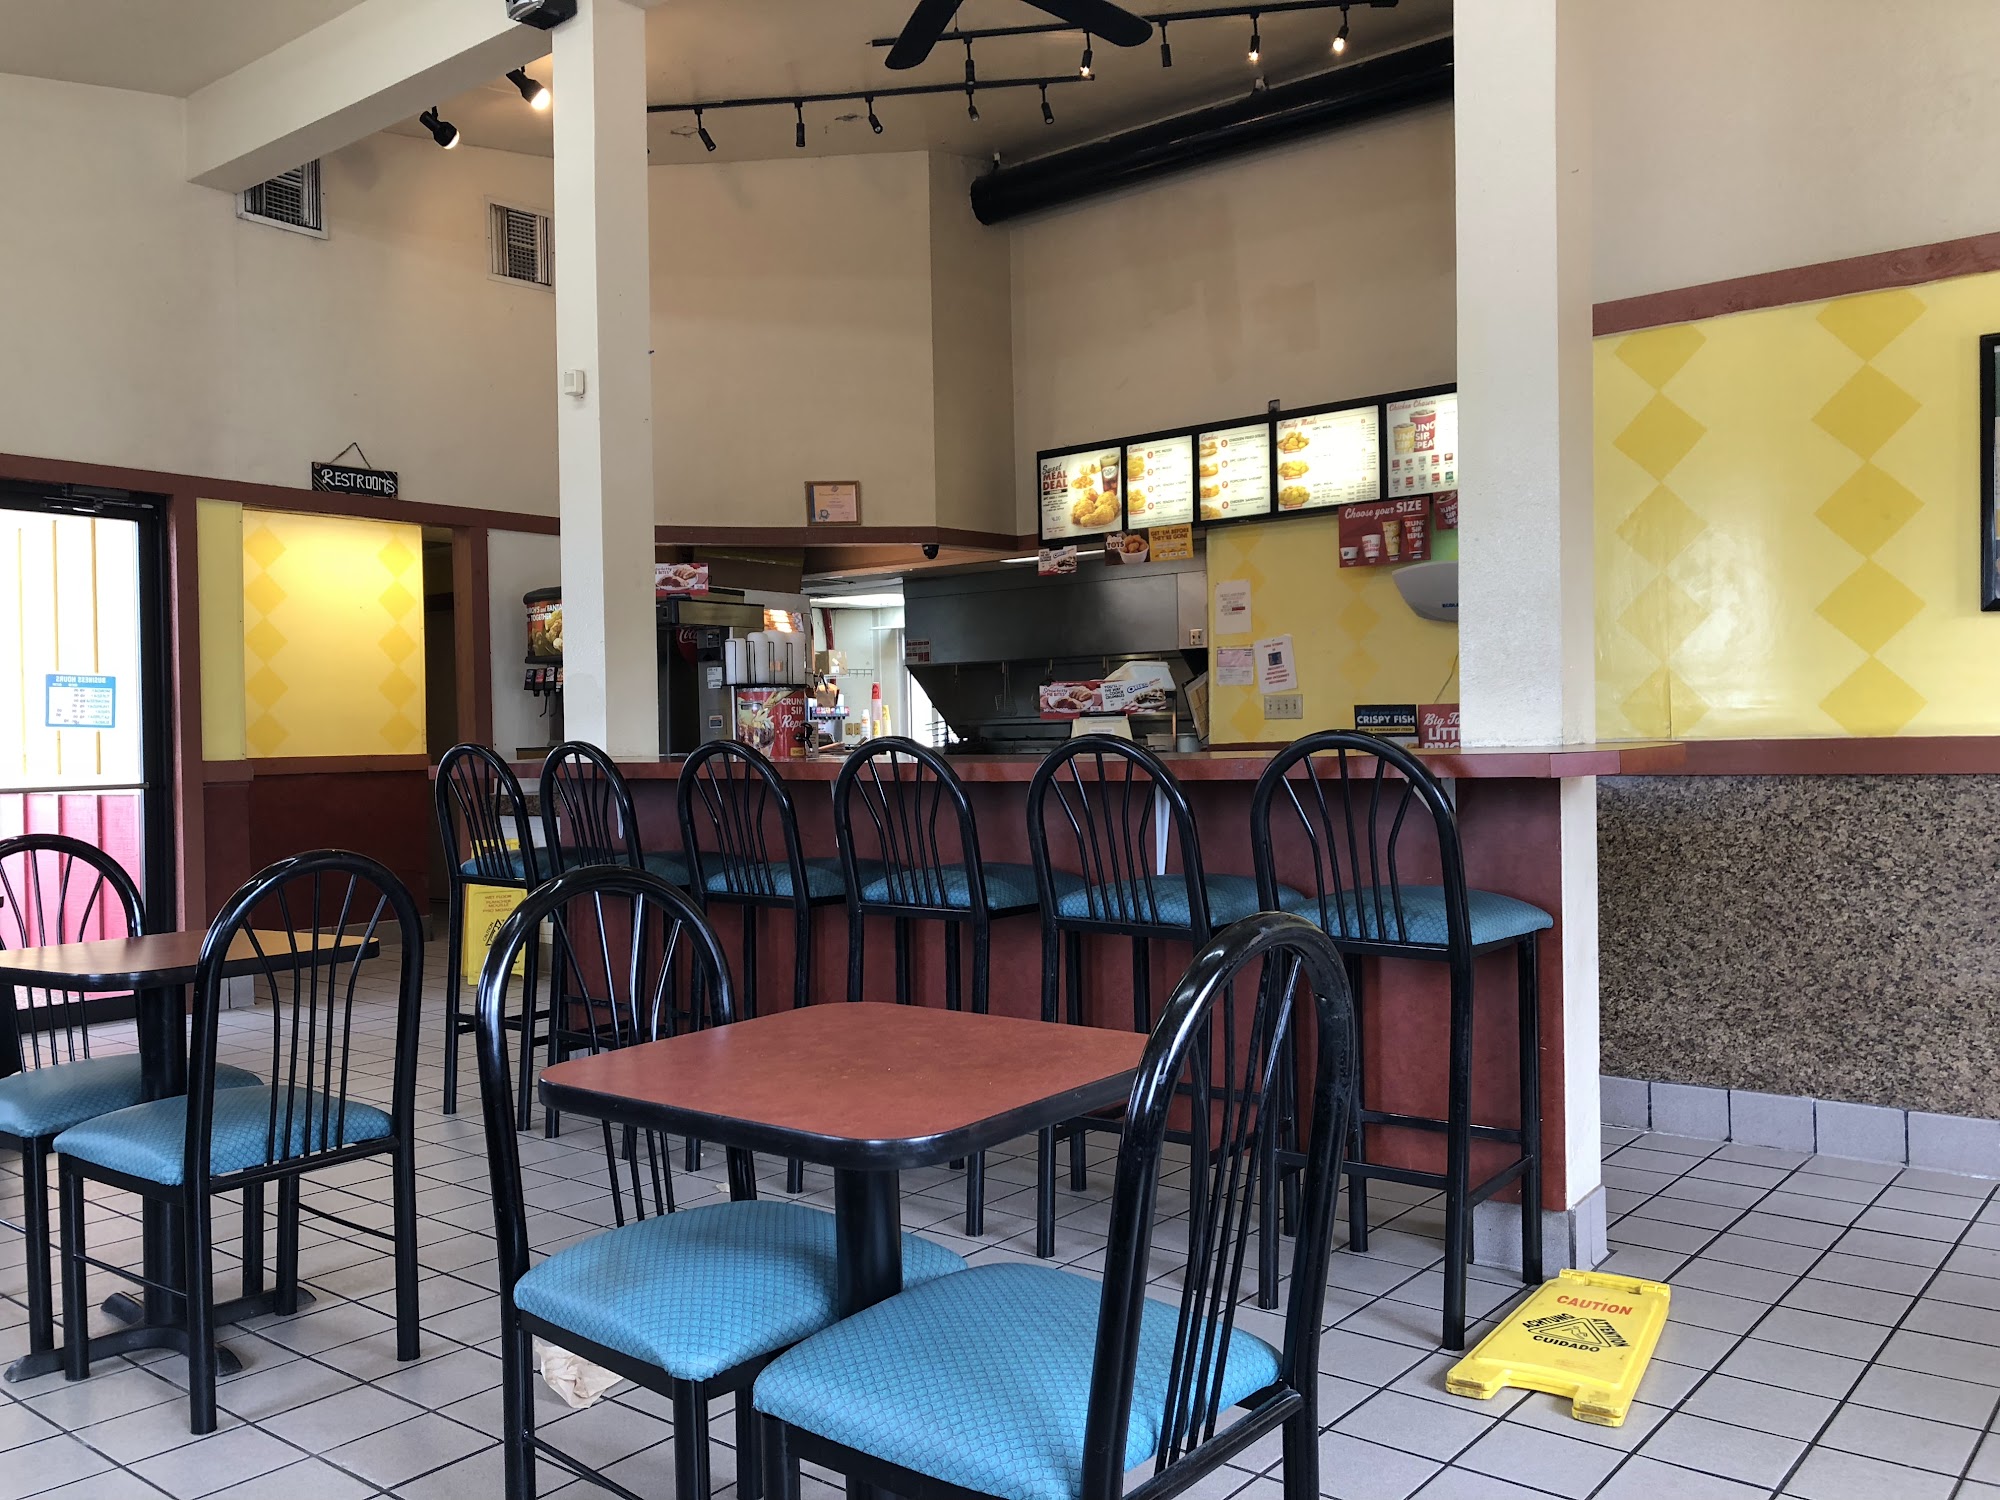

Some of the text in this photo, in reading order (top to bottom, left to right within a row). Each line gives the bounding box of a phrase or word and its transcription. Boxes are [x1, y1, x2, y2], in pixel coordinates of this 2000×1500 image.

[1389, 402, 1411, 412] Chicken
[1279, 422, 1298, 430] Family
[1042, 462, 1062, 475] Sweet
[1043, 470, 1067, 481] MEAL
[321, 469, 395, 494] RESTROOMS
[1043, 480, 1068, 490] DEAL
[1345, 500, 1422, 520] Choose your SIZE
[1357, 715, 1390, 723] CRISPY
[1424, 713, 1445, 729] Big
[483, 922, 494, 941] CAUTION
[1557, 1295, 1633, 1315] CAUTION
[1522, 1313, 1575, 1328] ACHTUNG
[1591, 1318, 1630, 1348] ATTENTION
[1533, 1335, 1600, 1352] CUIDADO
